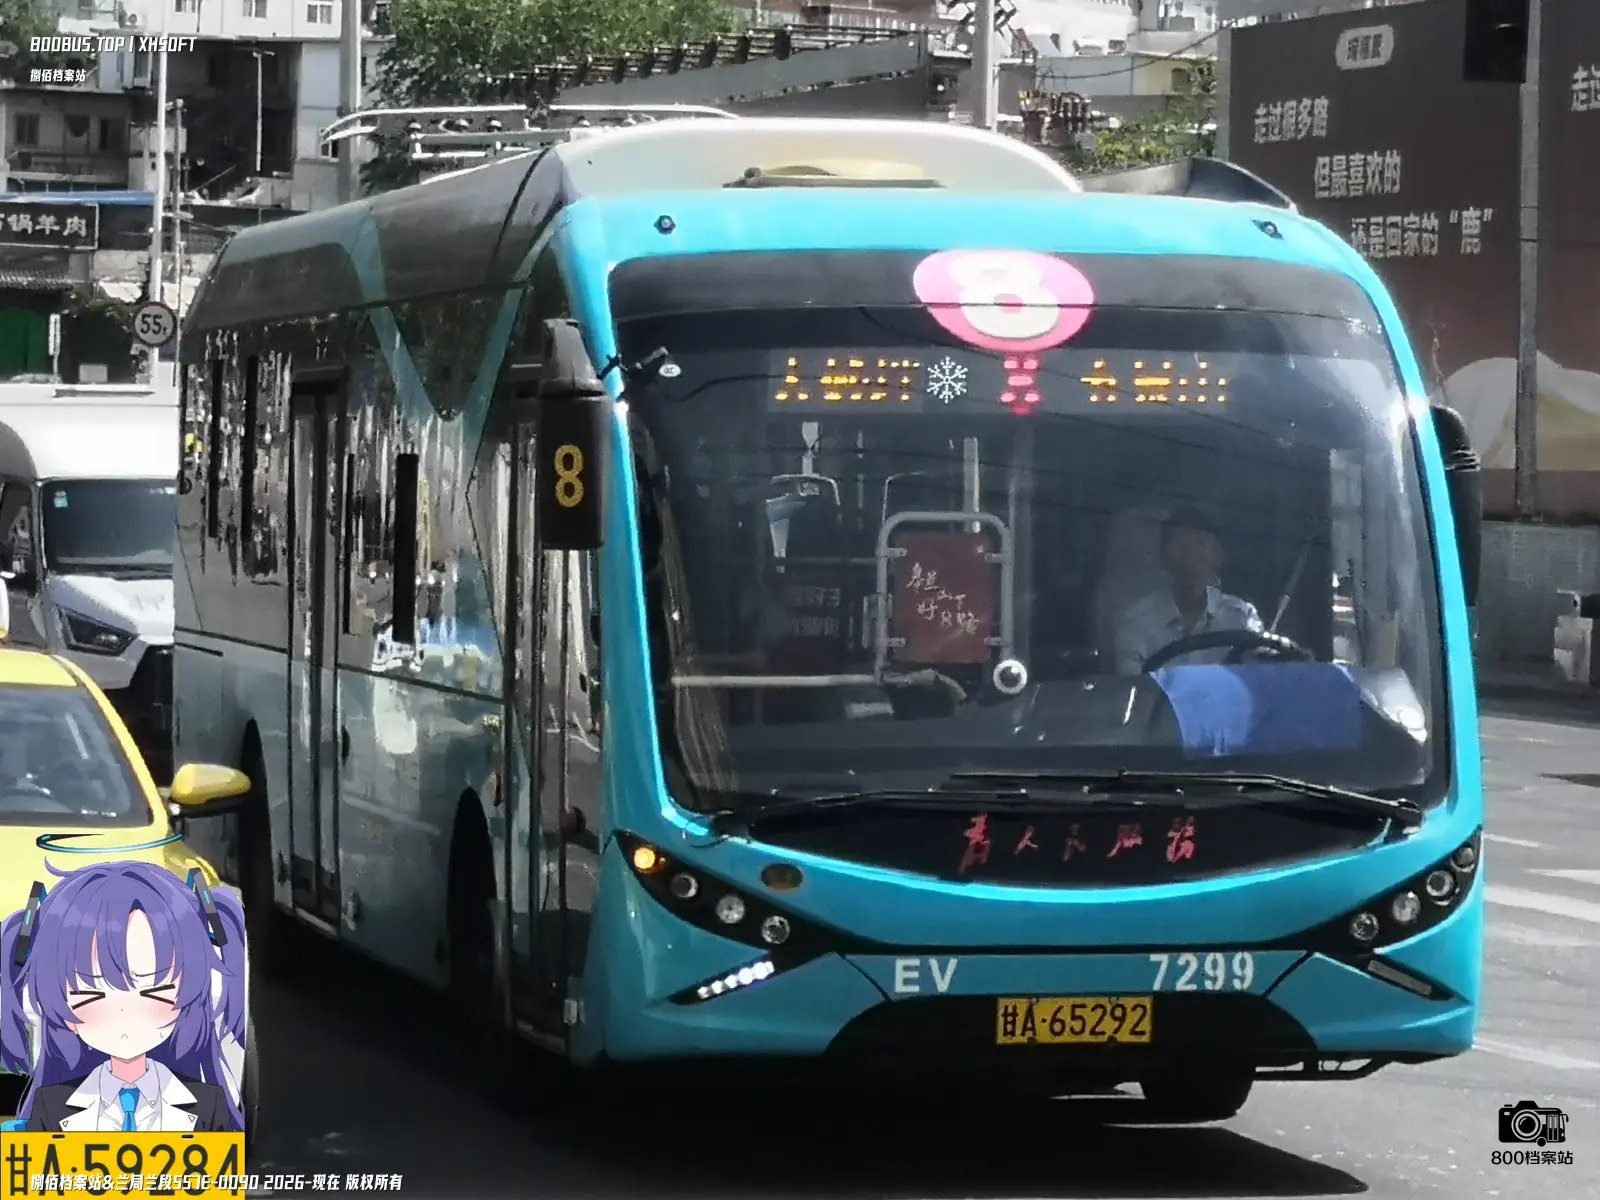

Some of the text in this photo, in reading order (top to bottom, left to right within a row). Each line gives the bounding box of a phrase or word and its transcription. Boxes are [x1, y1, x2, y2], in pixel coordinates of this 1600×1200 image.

[1314, 149, 1401, 199] 但最喜欢的
[949, 249, 1060, 339] 8
[554, 444, 584, 508] 8
[894, 951, 1255, 993] EV 7299
